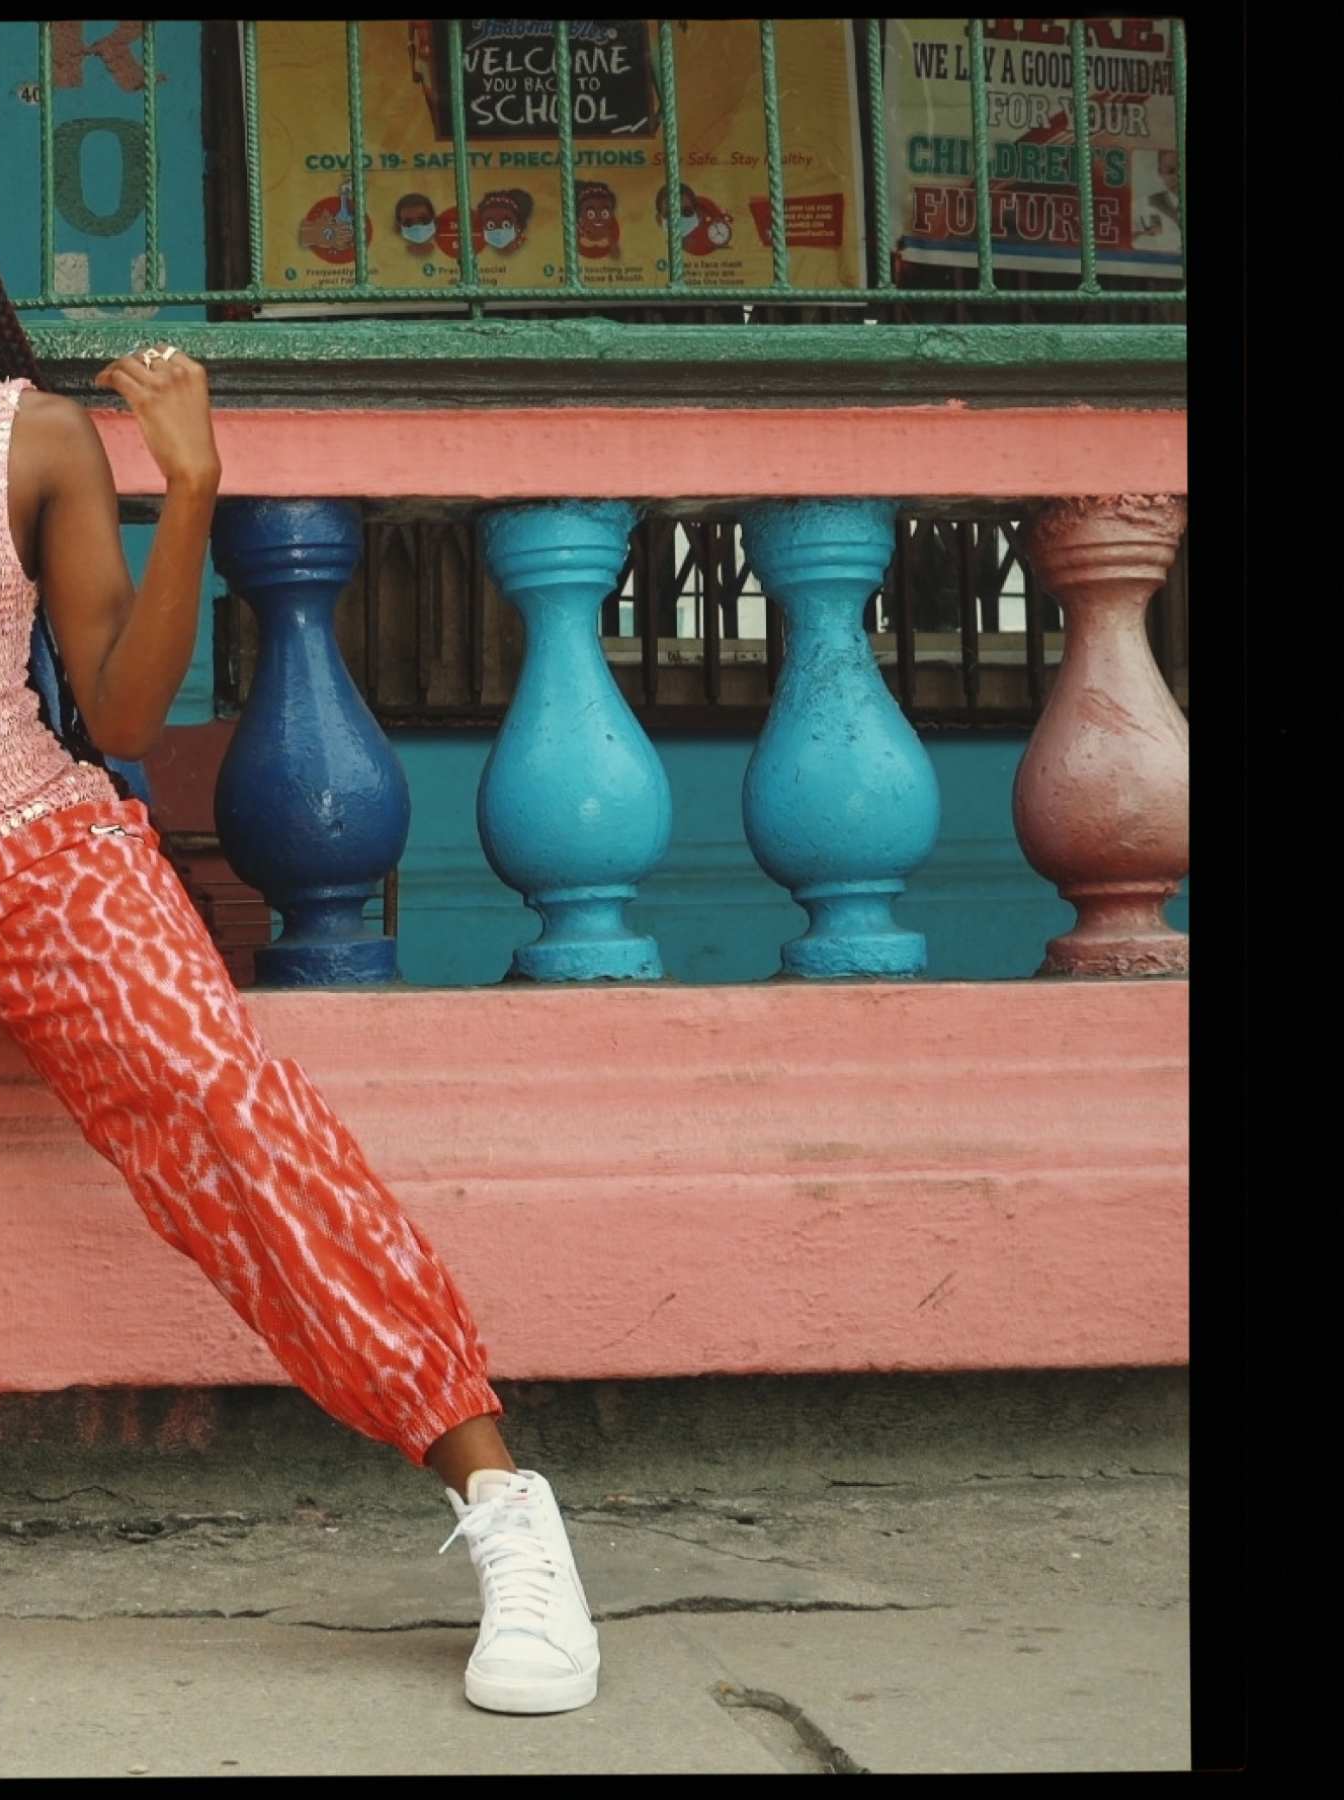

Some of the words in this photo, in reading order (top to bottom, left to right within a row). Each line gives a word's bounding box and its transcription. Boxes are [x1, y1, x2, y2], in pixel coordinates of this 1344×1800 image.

[913, 43, 948, 79] WE
[1002, 49, 1015, 84] A
[1022, 51, 1072, 88] GOOD
[483, 77, 517, 92] YOU
[524, 76, 558, 91] BAC
[577, 77, 601, 91] TO
[986, 90, 1052, 130] FOR
[413, 152, 492, 169] SAFTY
